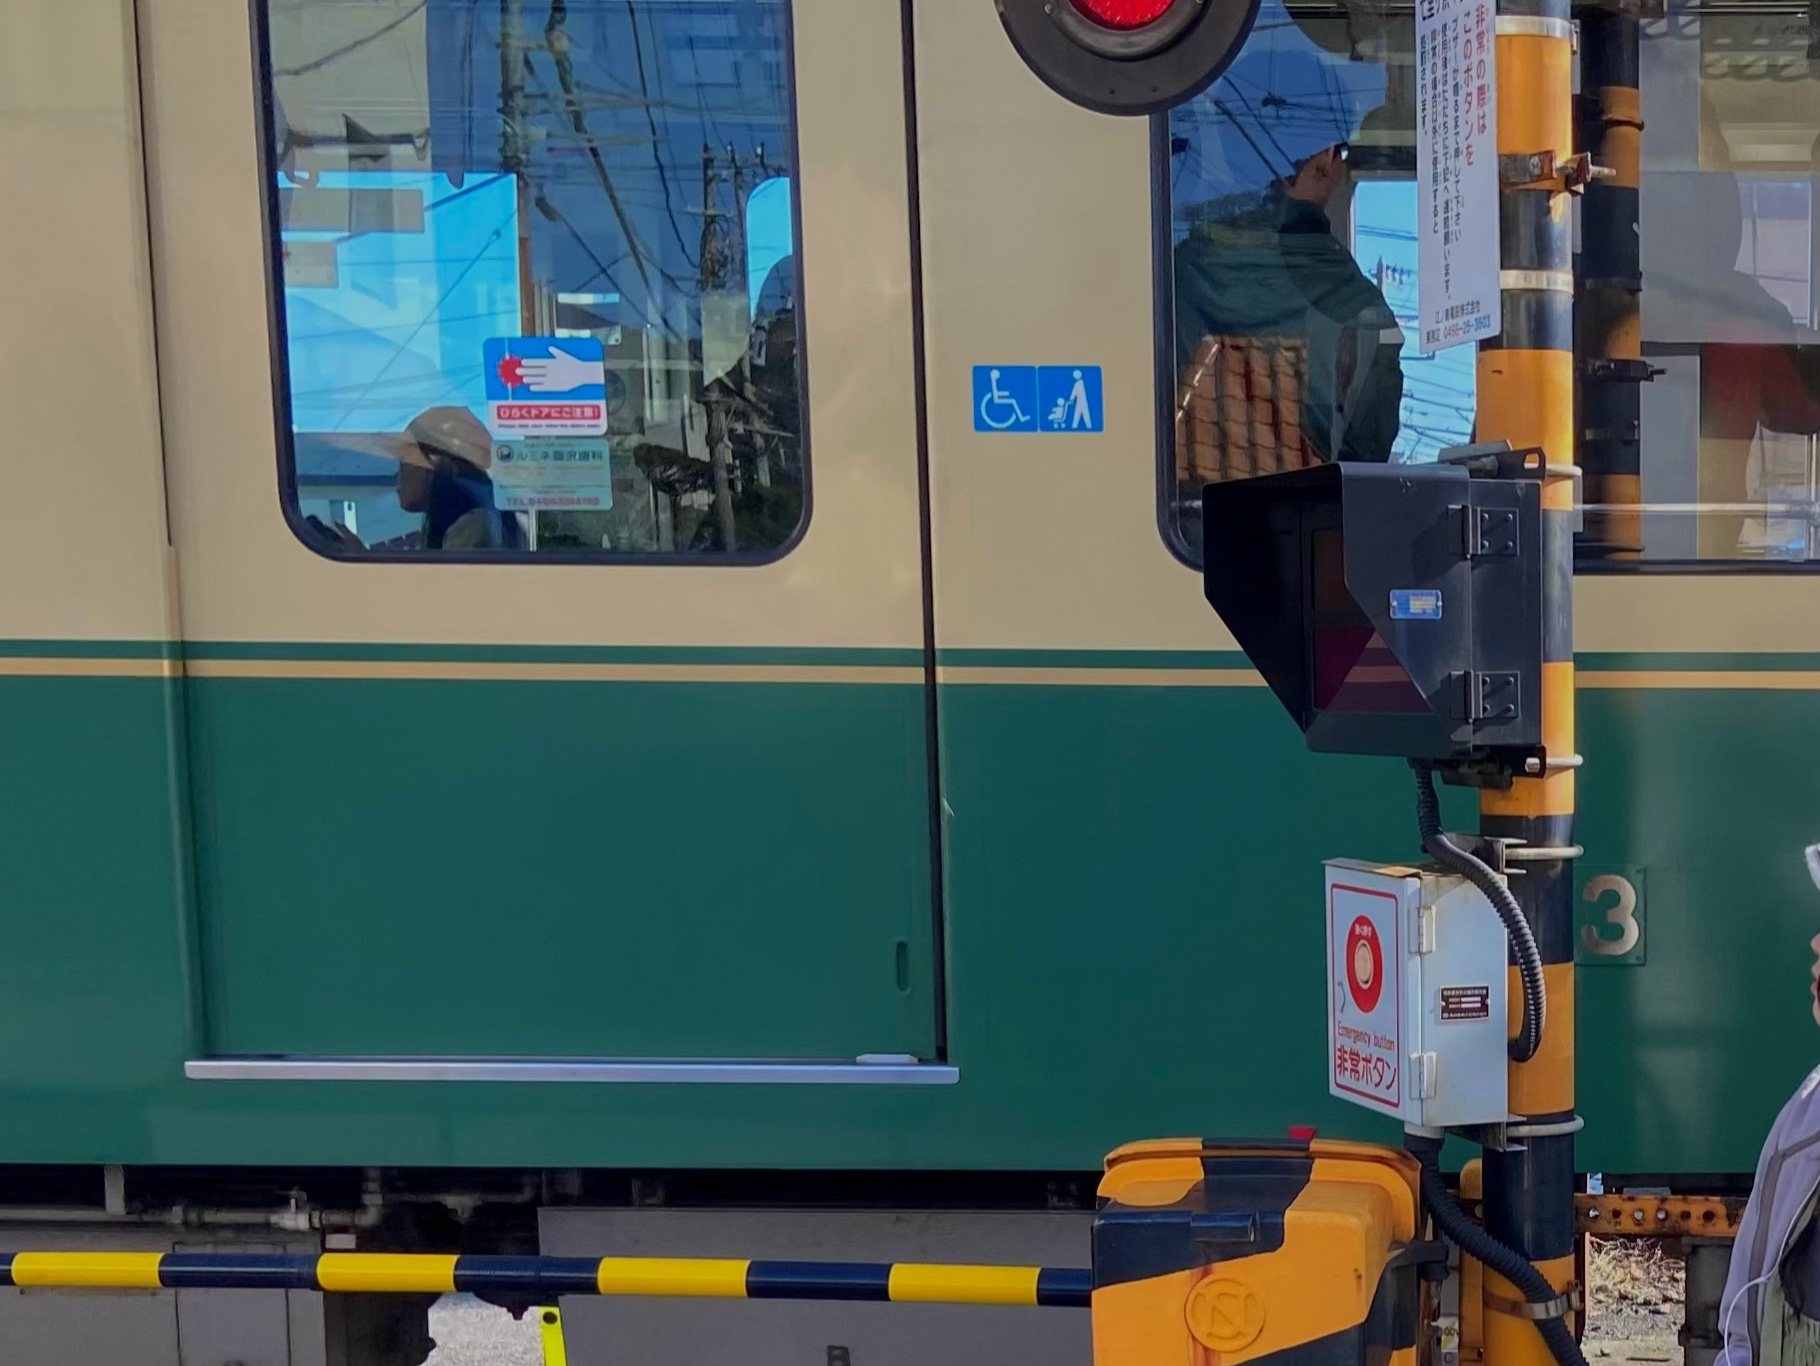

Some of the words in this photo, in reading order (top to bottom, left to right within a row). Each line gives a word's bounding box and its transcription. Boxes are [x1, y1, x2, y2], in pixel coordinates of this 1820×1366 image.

[1463, 11, 1473, 167] このボタンを
[1581, 874, 1640, 955] 3
[1337, 1020, 1371, 1048] Emergency
[1373, 1030, 1395, 1052] button
[1337, 1045, 1397, 1091] 非常ボタン
